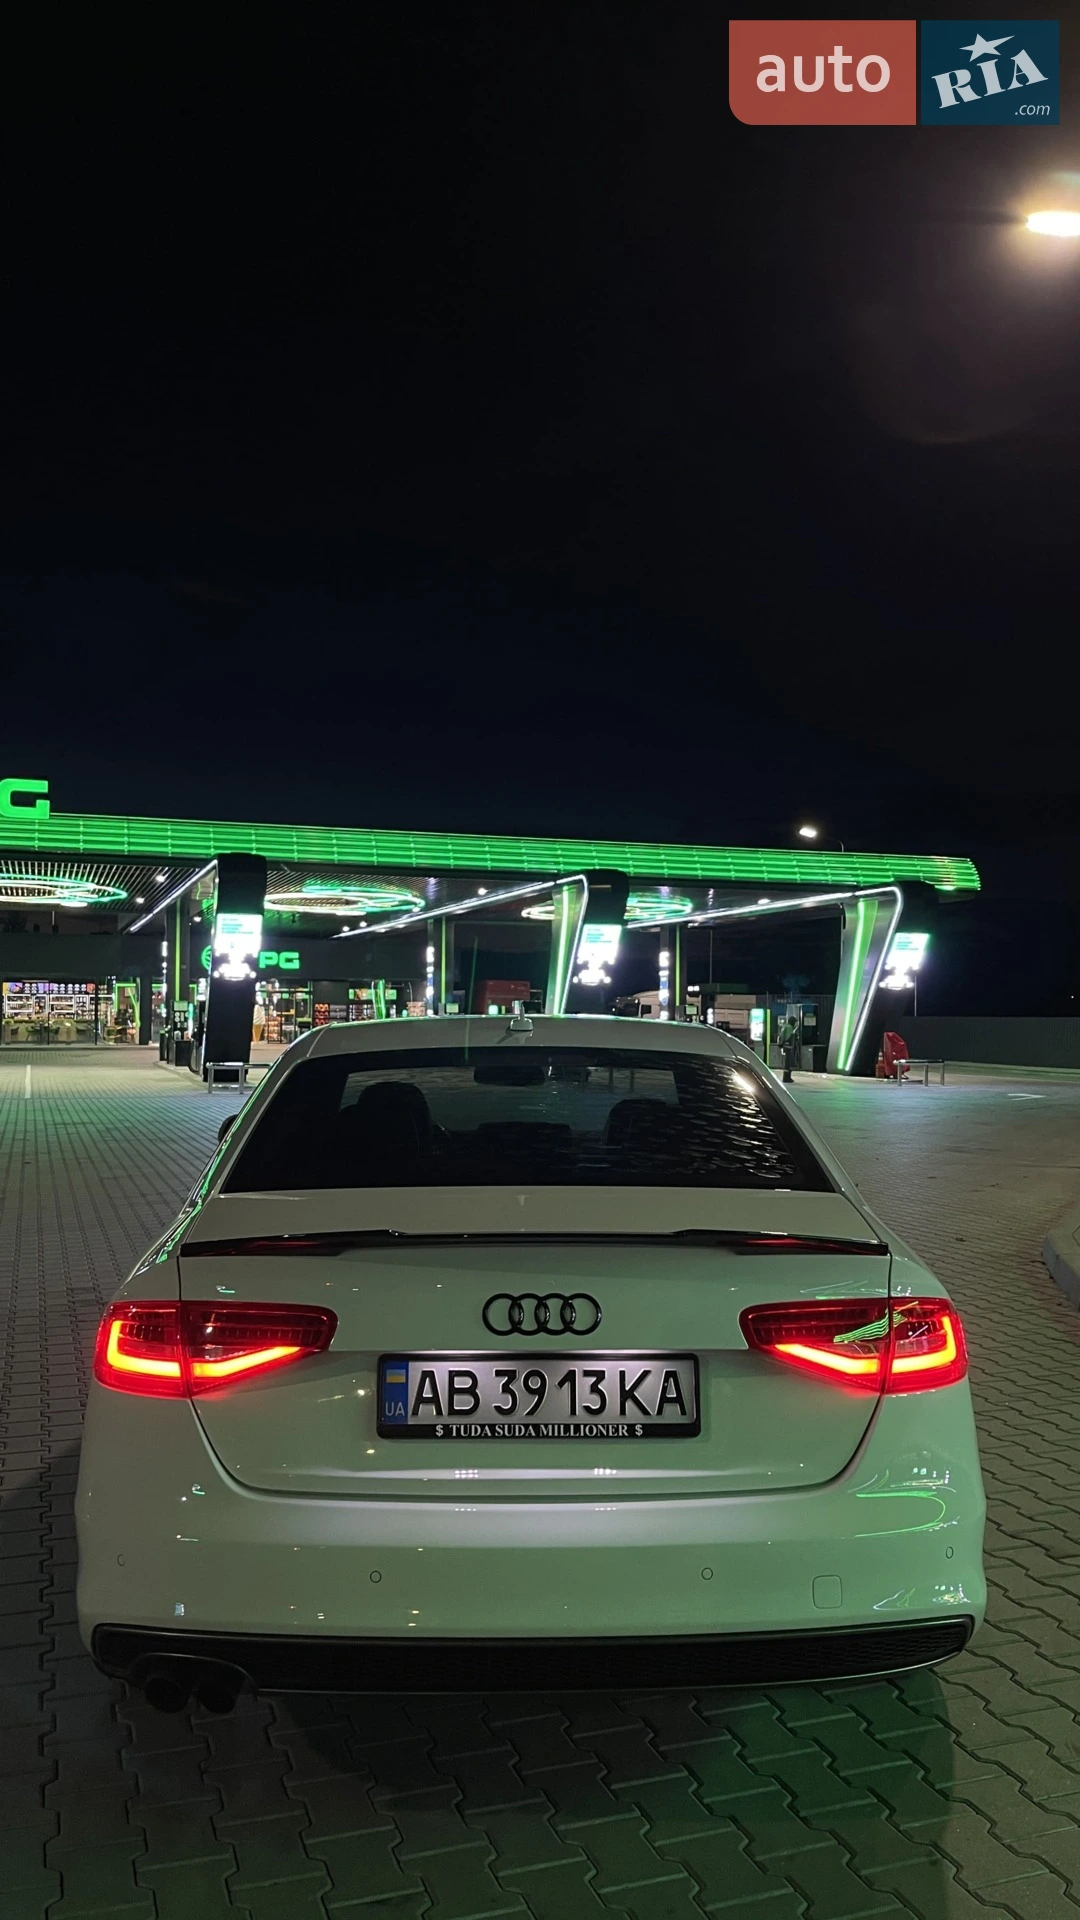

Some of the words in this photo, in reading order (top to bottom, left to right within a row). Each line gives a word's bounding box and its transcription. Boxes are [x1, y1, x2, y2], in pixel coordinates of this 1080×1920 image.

[410, 1368, 481, 1417] AB
[492, 1368, 609, 1417] 3913
[618, 1368, 688, 1417] KA
[385, 1401, 405, 1417] UA
[449, 1424, 492, 1437] TUDA
[495, 1424, 537, 1437] SUDA
[539, 1424, 629, 1437] MILLIONER
